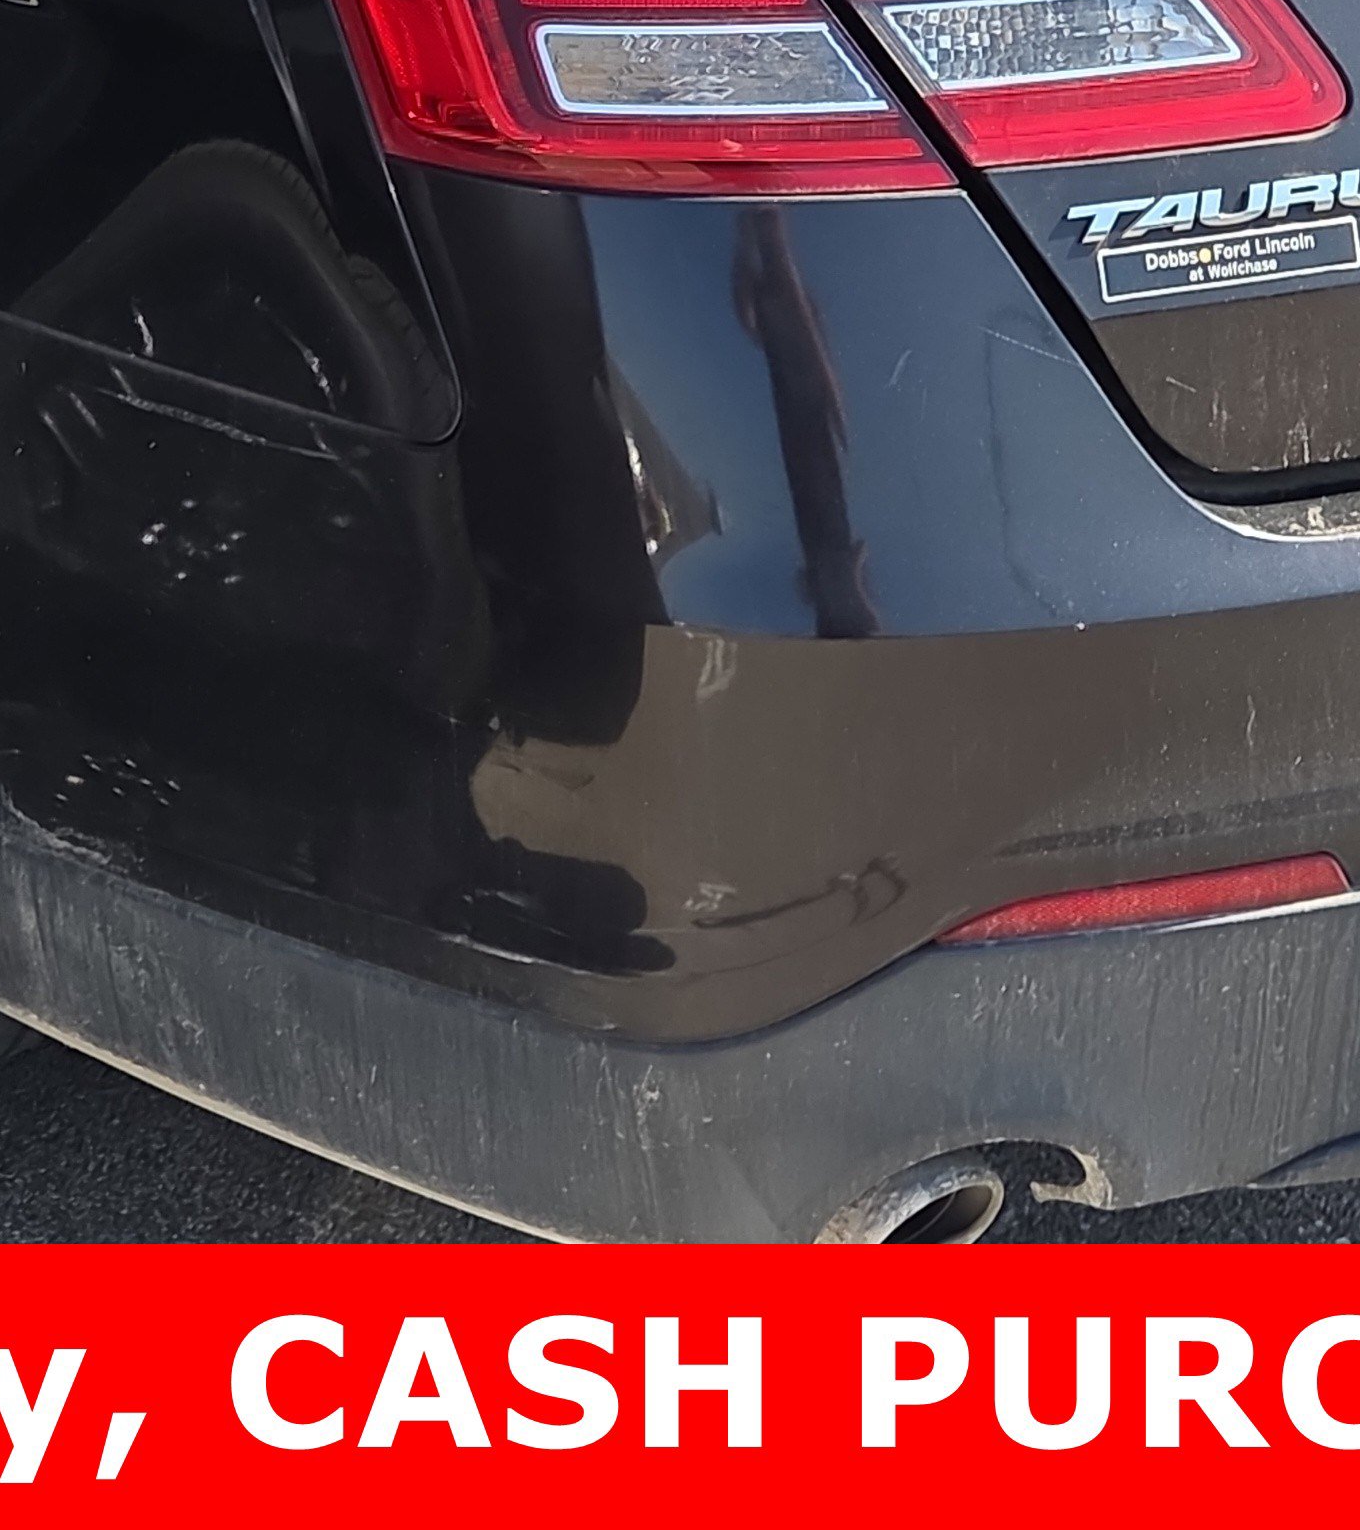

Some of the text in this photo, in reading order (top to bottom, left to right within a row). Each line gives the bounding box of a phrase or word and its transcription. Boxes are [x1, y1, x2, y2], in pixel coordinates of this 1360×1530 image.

[1145, 232, 1316, 271] Dobbs Ford Lincoln
[1188, 259, 1278, 282] at Wolfchase
